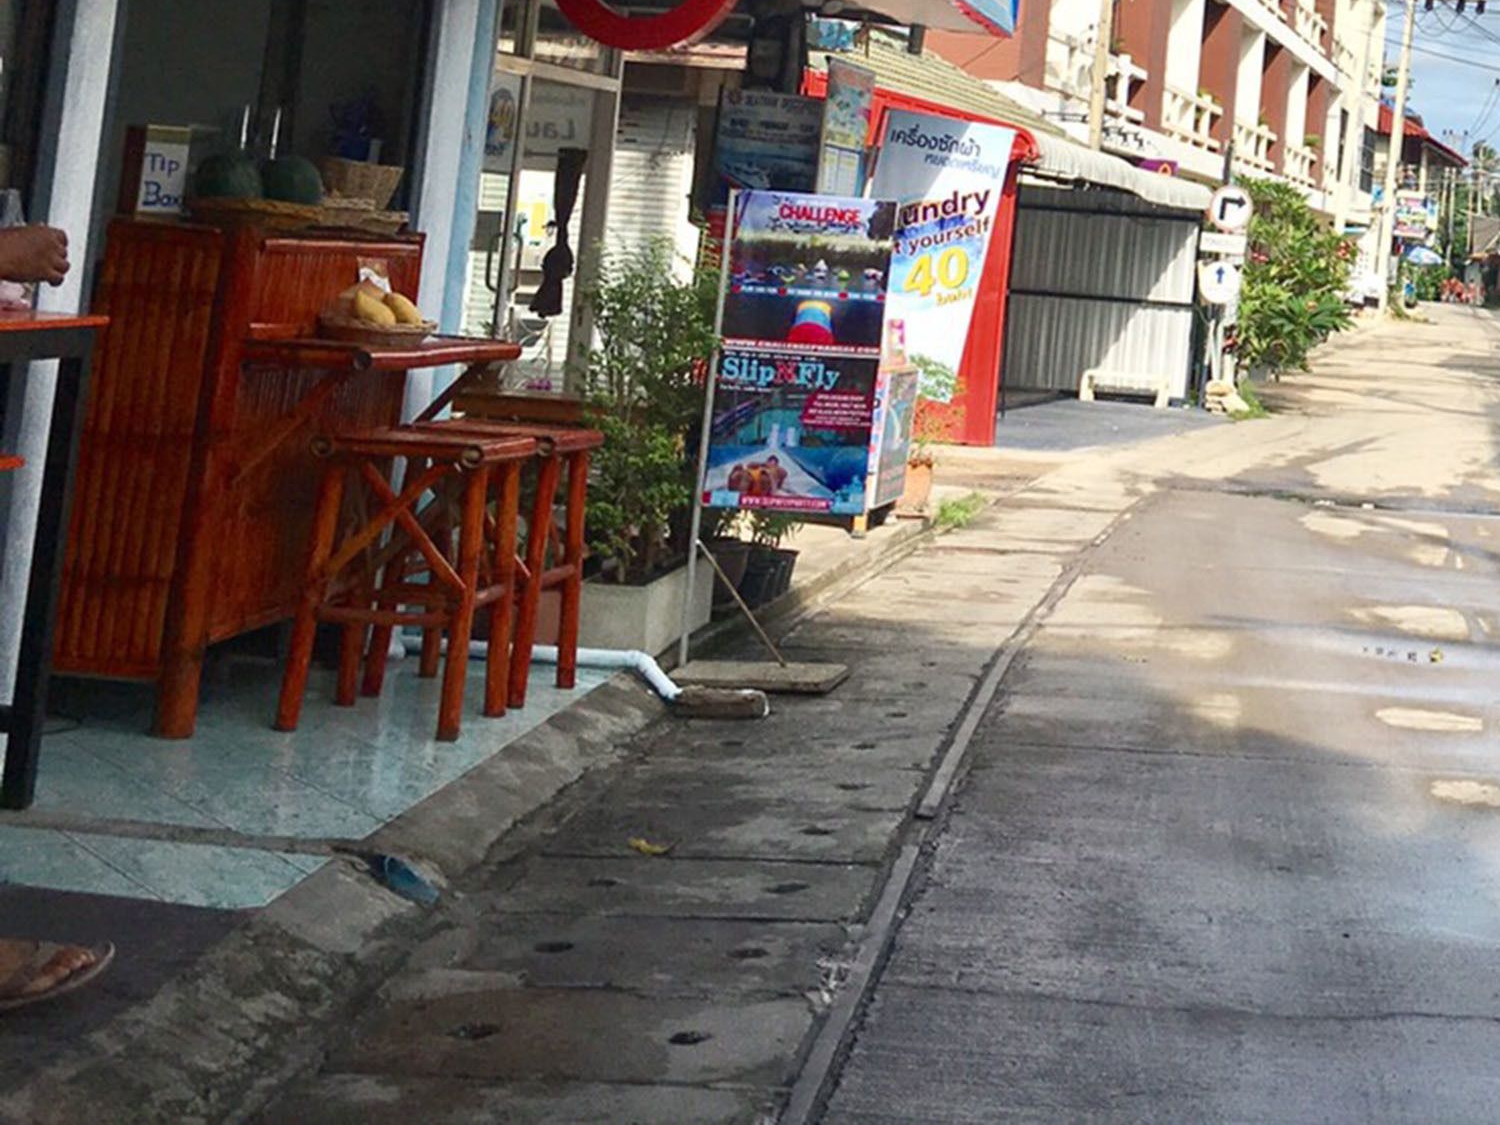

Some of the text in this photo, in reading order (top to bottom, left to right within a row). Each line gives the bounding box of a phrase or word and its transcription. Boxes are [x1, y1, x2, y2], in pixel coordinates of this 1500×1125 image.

[144, 152, 180, 178] Tip
[142, 180, 183, 208] Box
[901, 189, 990, 226] undry
[778, 201, 862, 226] CHALLENGE
[908, 216, 990, 256] yourself
[903, 246, 970, 297] 40
